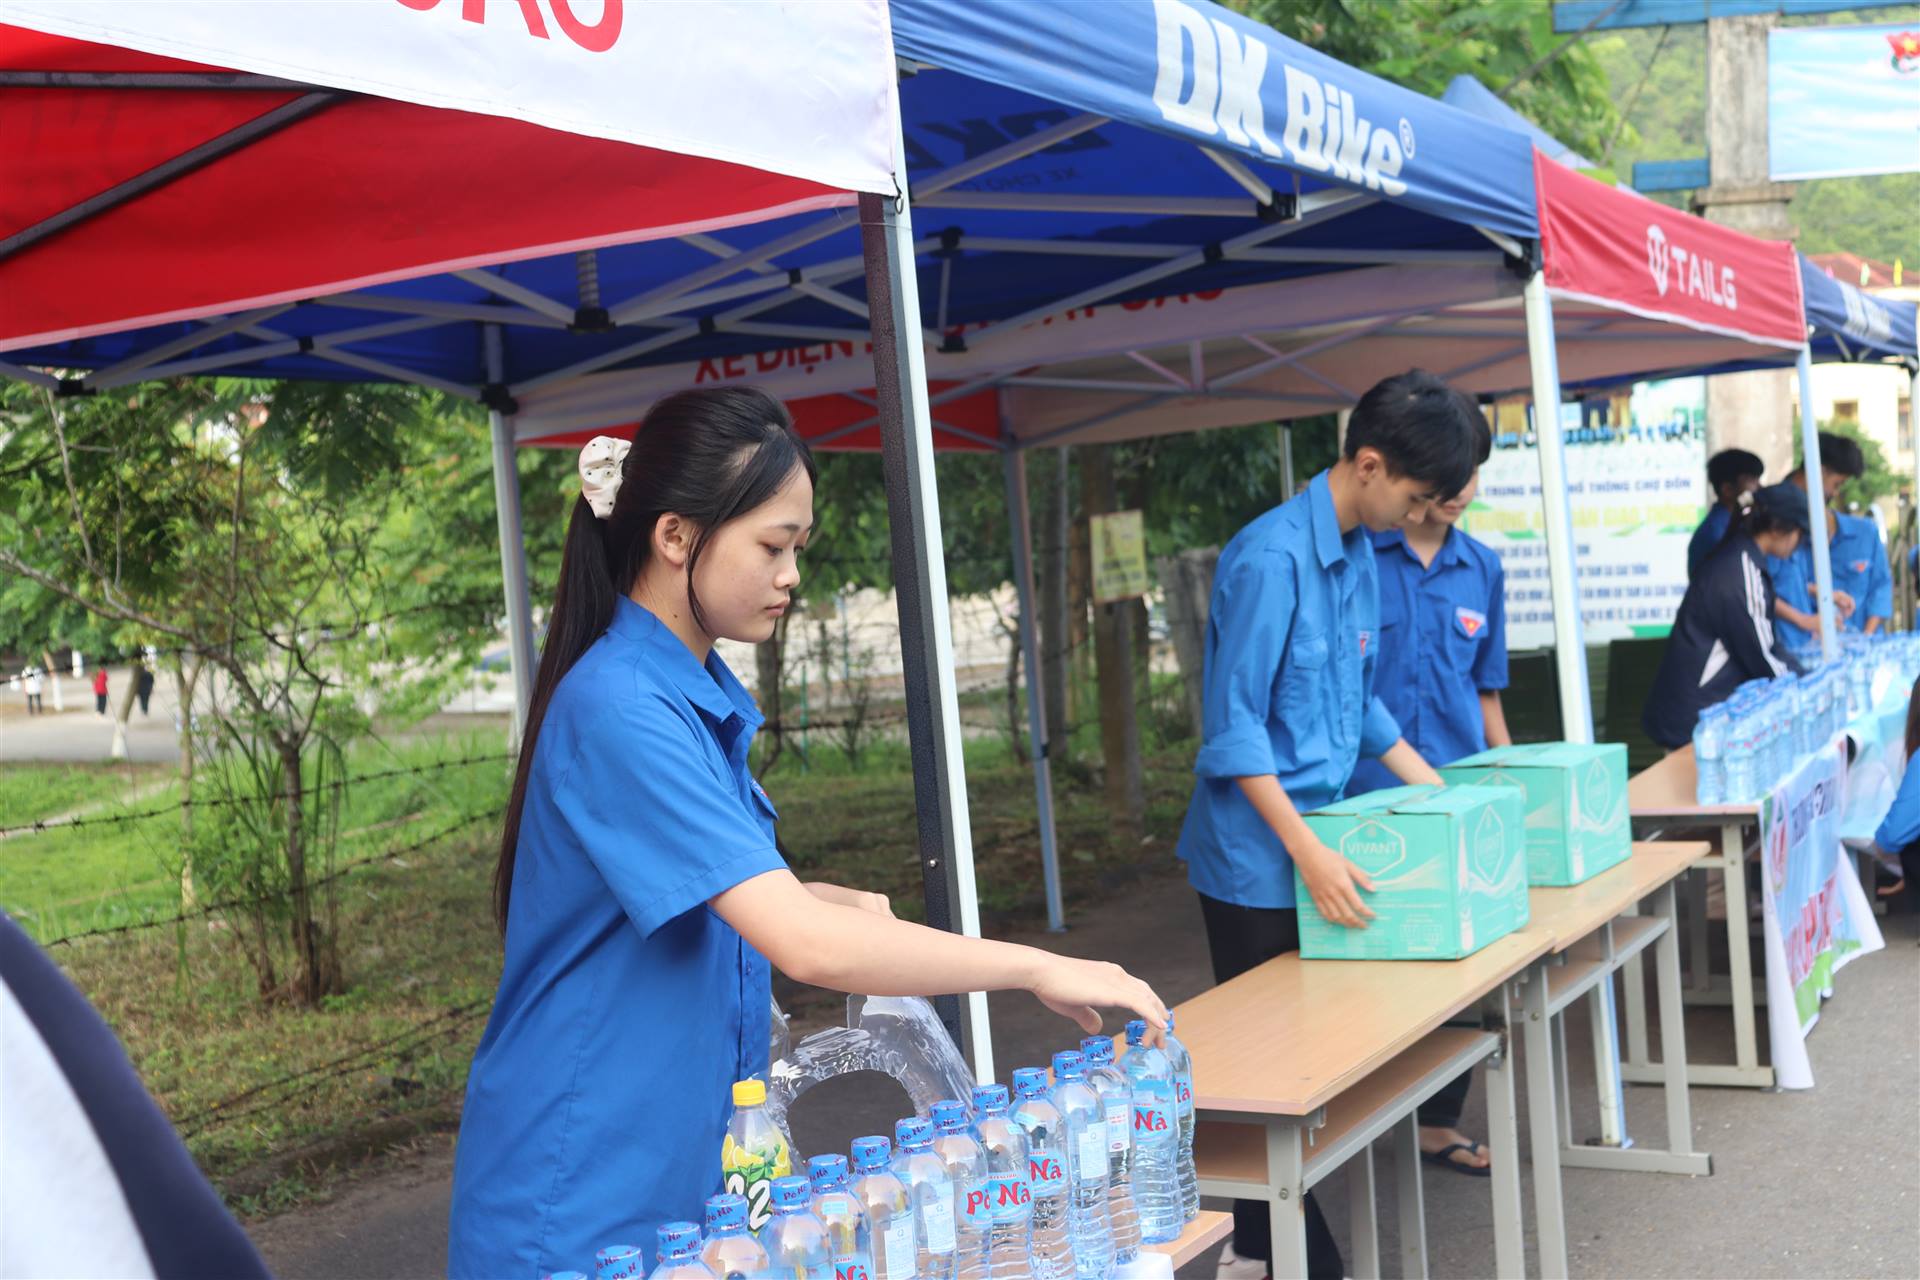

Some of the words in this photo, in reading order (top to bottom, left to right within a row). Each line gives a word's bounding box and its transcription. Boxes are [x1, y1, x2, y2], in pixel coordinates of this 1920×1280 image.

[1152, 0, 1283, 158] DK
[1670, 247, 1738, 310] TAILG
[1346, 840, 1398, 855] VIVANT
[1134, 1110, 1168, 1132] Nà
[1029, 1159, 1063, 1181] Nà
[998, 1181, 1032, 1206] Nà
